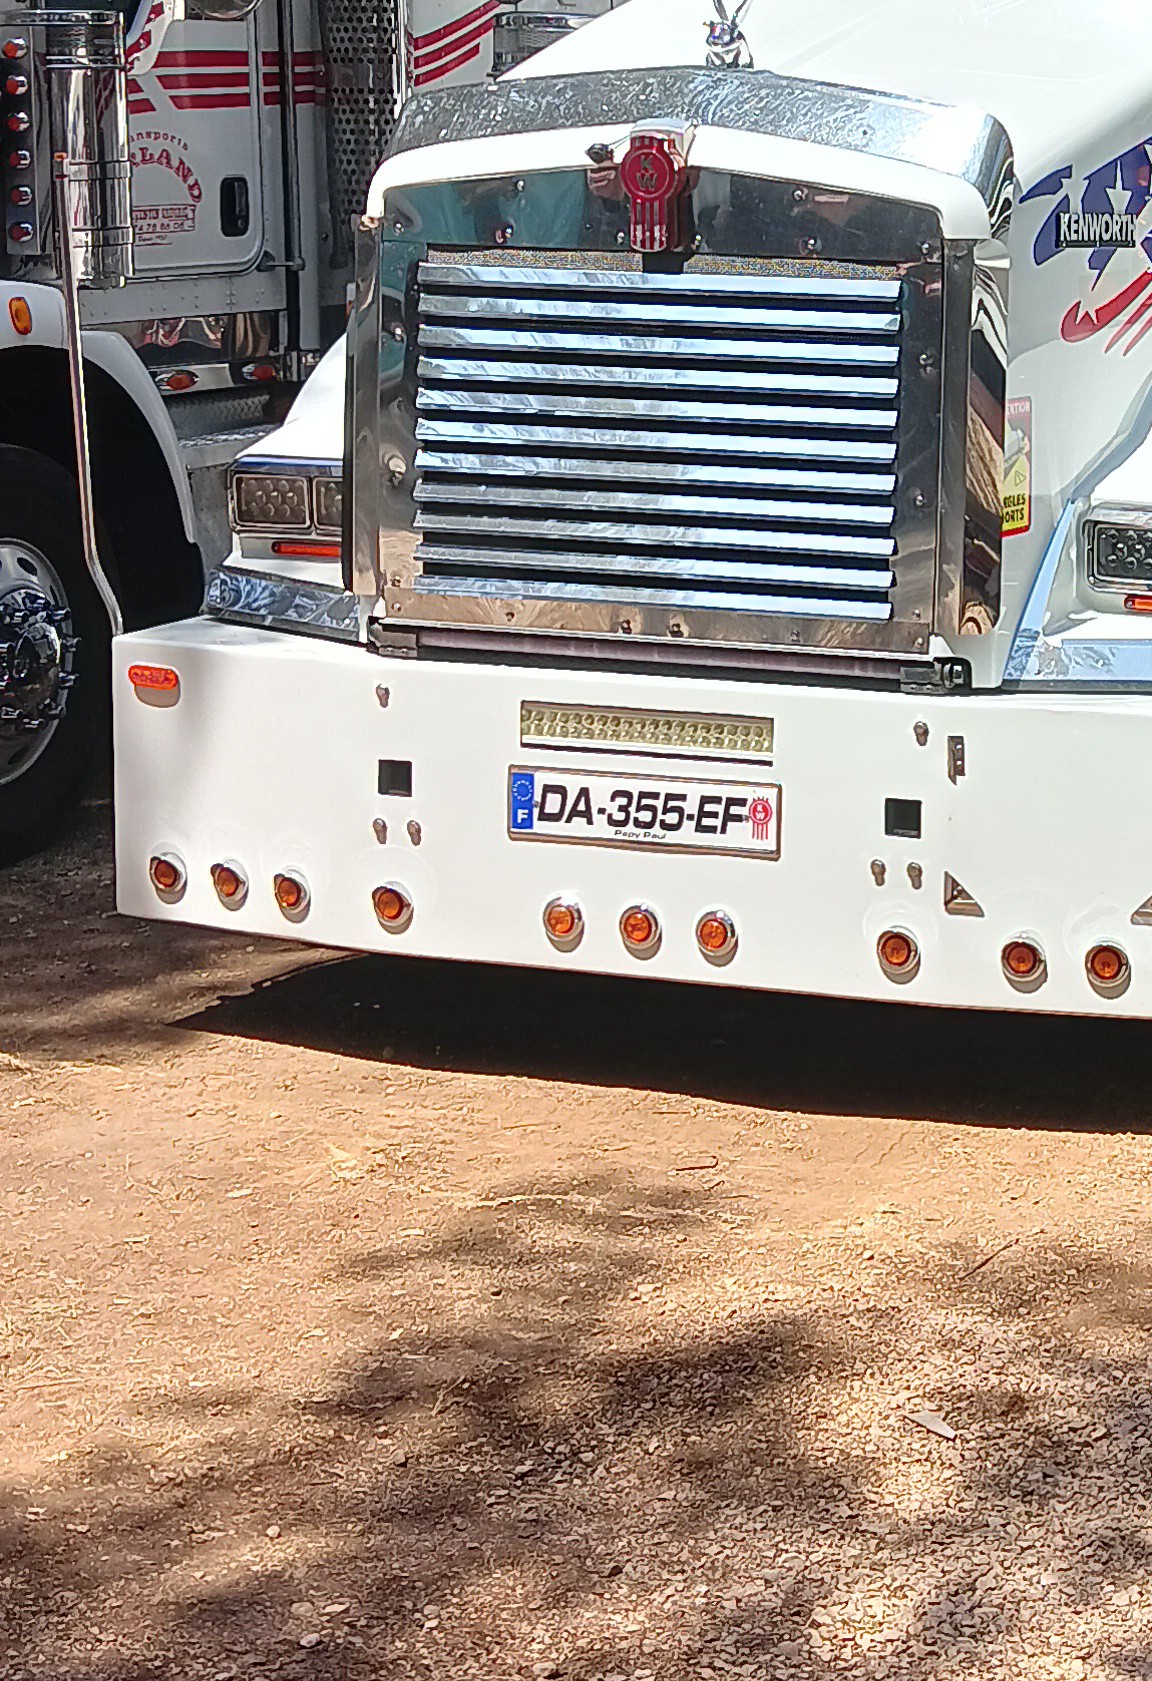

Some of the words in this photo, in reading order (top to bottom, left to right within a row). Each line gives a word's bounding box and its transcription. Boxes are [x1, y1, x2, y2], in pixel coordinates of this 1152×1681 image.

[1059, 212, 1138, 242] KENWORTH
[1002, 507, 1025, 523] ORTS
[516, 808, 529, 824] F
[537, 783, 748, 835] DA-355-EF
[614, 829, 641, 839] Papy
[643, 831, 667, 840] Paul
